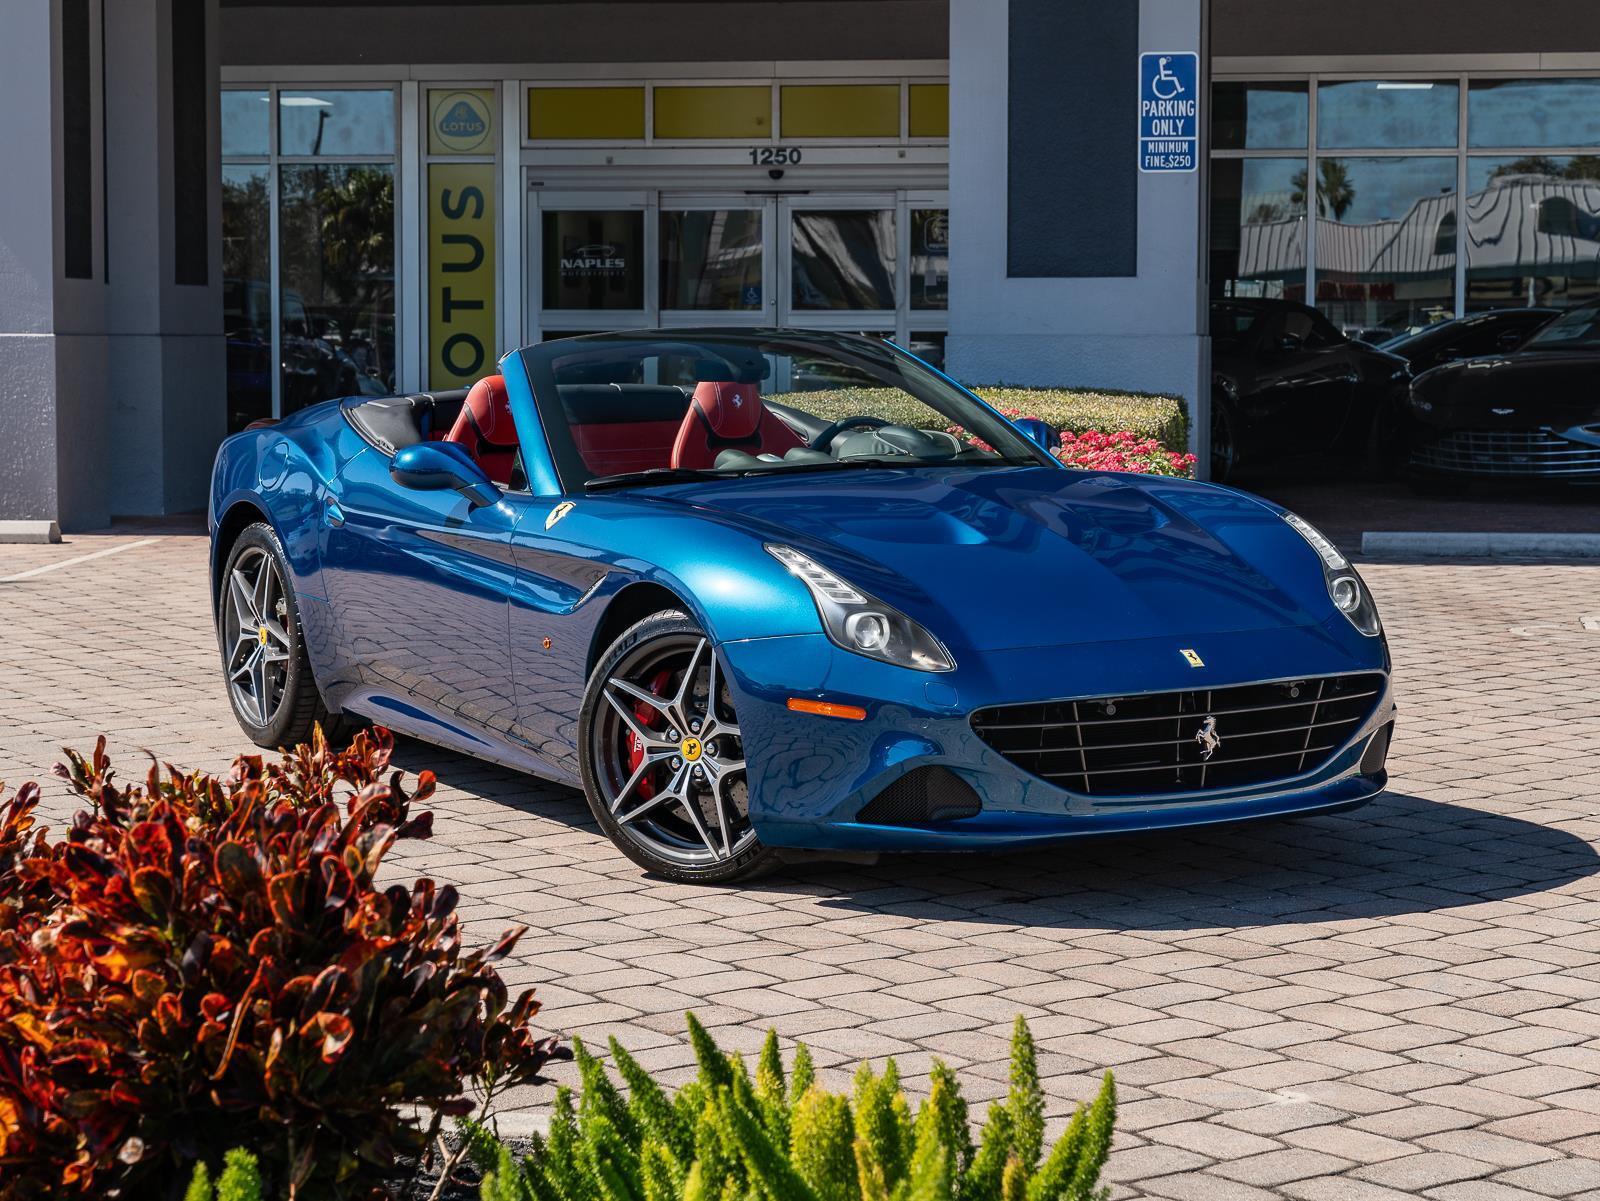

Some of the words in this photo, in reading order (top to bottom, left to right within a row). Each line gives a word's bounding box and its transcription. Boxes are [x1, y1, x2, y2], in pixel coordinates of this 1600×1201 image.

[1142, 100, 1195, 117] PARKING
[442, 121, 482, 132] LOTUS
[1152, 119, 1184, 135] ONLY
[1147, 141, 1188, 153] MINIMUM
[749, 147, 802, 165] 1250
[1145, 155, 1166, 167] FINE
[1168, 155, 1191, 168] $250
[560, 258, 625, 269] NAPLES
[441, 185, 485, 377] OTUS
